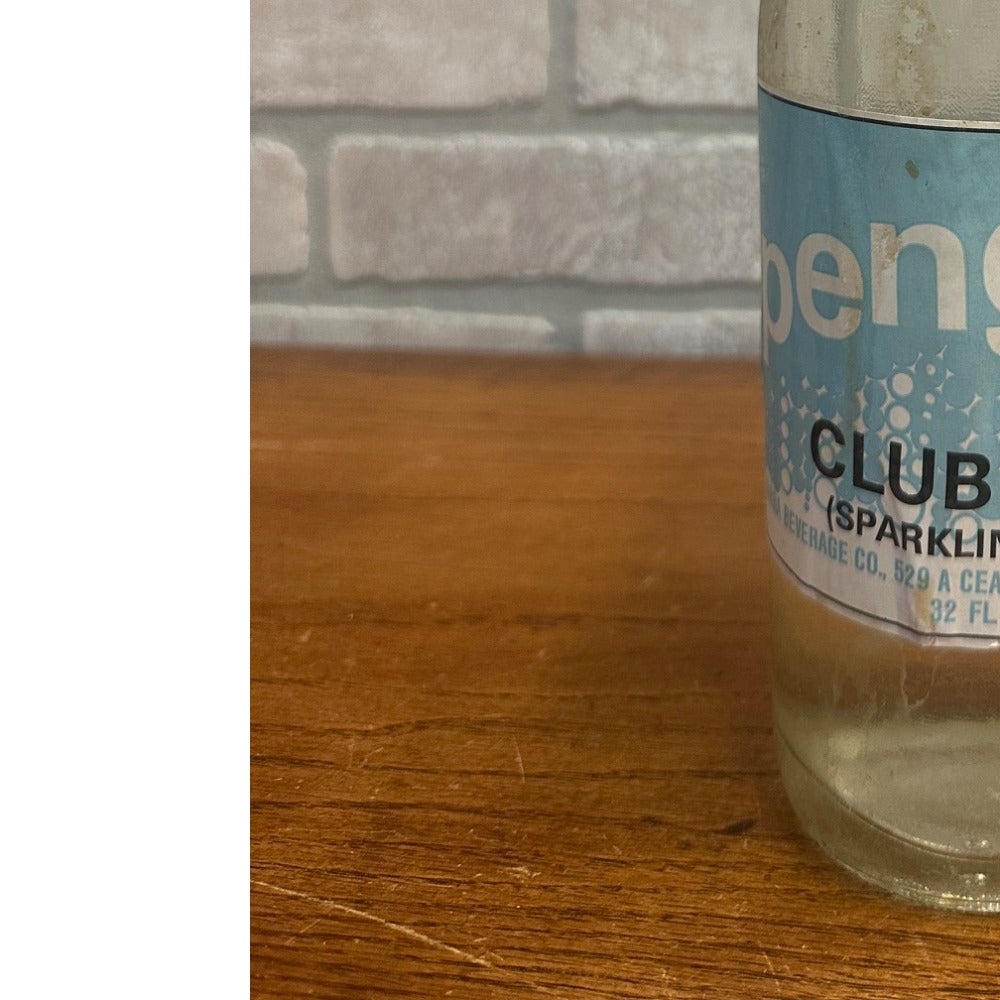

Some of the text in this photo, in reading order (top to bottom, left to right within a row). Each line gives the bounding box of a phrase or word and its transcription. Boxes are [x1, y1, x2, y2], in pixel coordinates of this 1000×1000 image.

[810, 419, 991, 510] CLUB
[783, 505, 848, 565] BEVERAGE
[854, 546, 886, 581] CO.,
[894, 559, 930, 592] 529
[937, 569, 951, 593] A
[931, 599, 957, 623] 32
